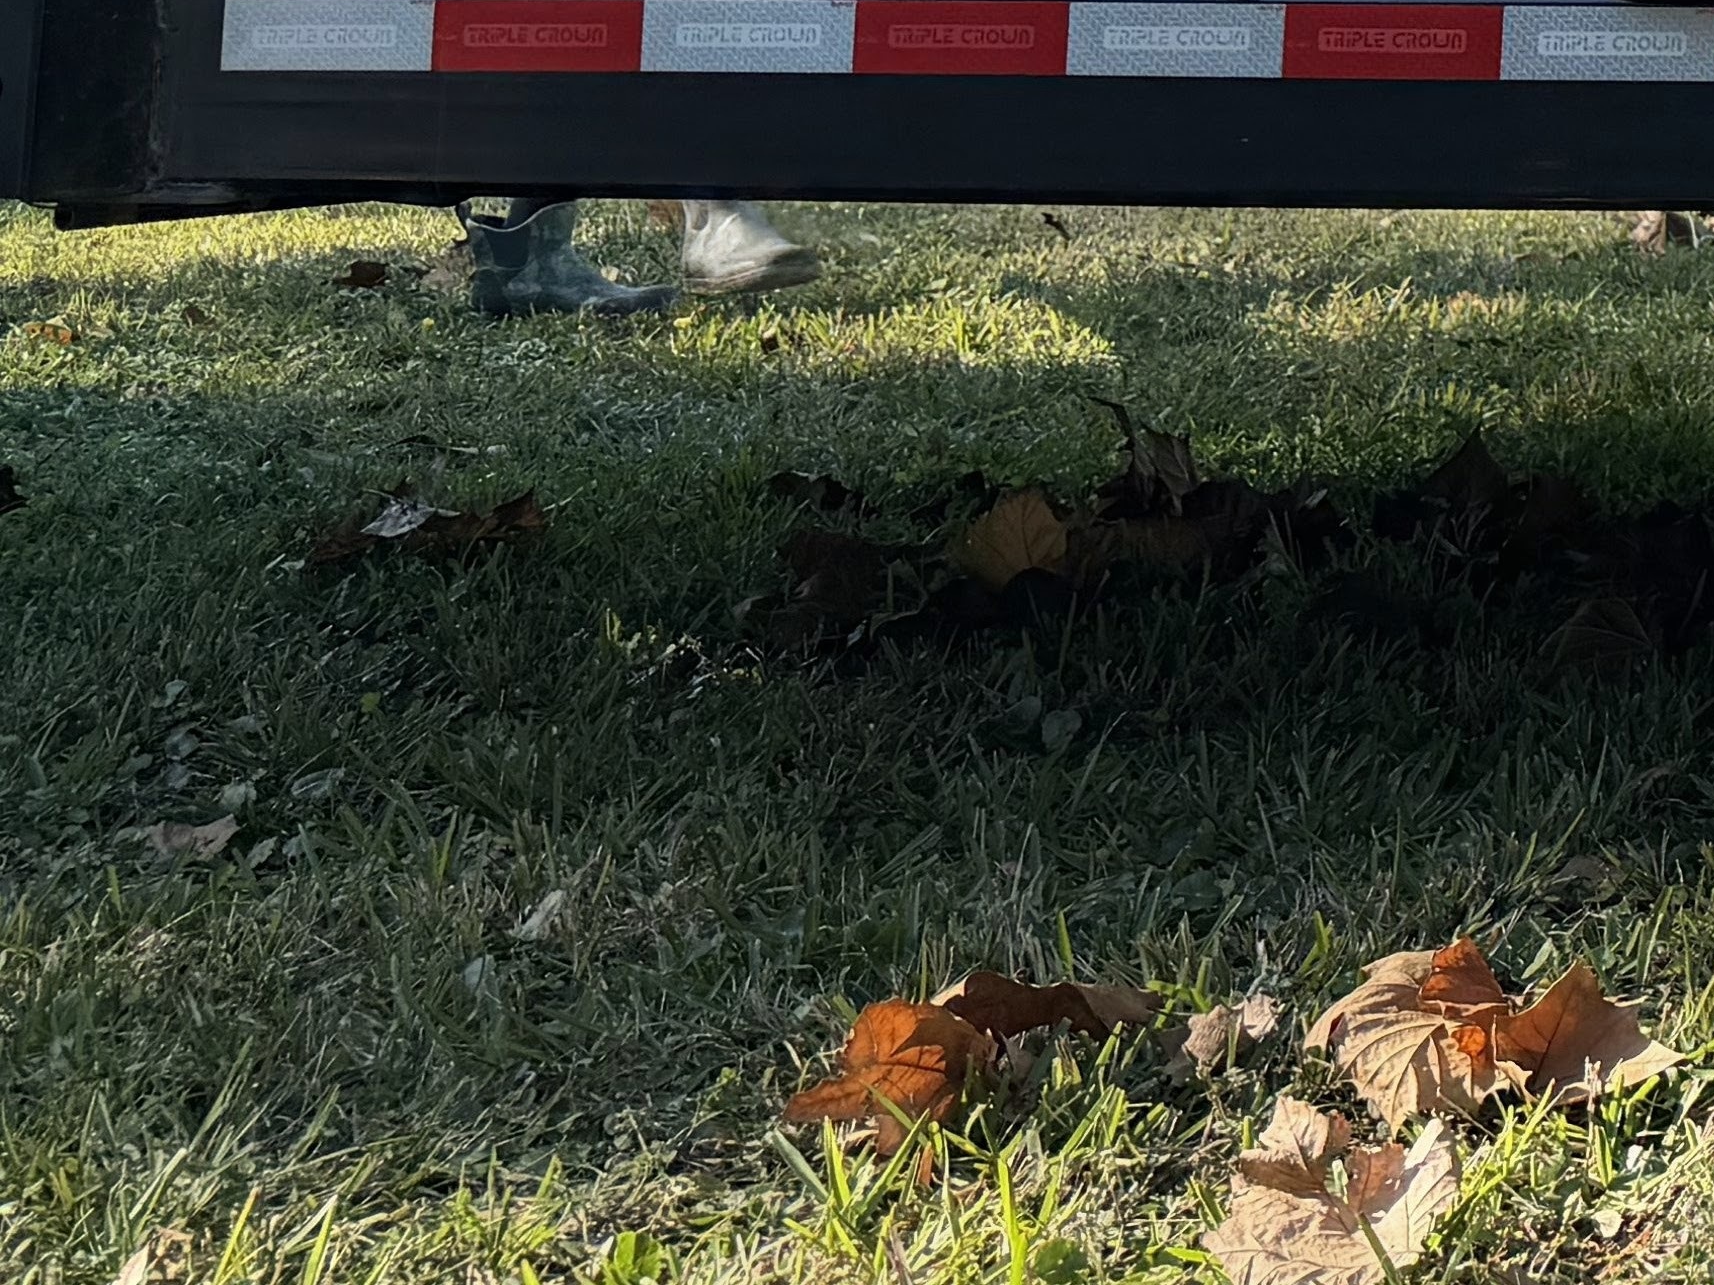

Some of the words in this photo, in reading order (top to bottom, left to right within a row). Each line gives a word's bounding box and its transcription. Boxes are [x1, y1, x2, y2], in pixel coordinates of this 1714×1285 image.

[1323, 31, 1385, 48] TRIPLE
[1392, 31, 1462, 48] CROWN
[1541, 34, 1605, 52] TRIPLE
[1612, 34, 1683, 52] CROWN
